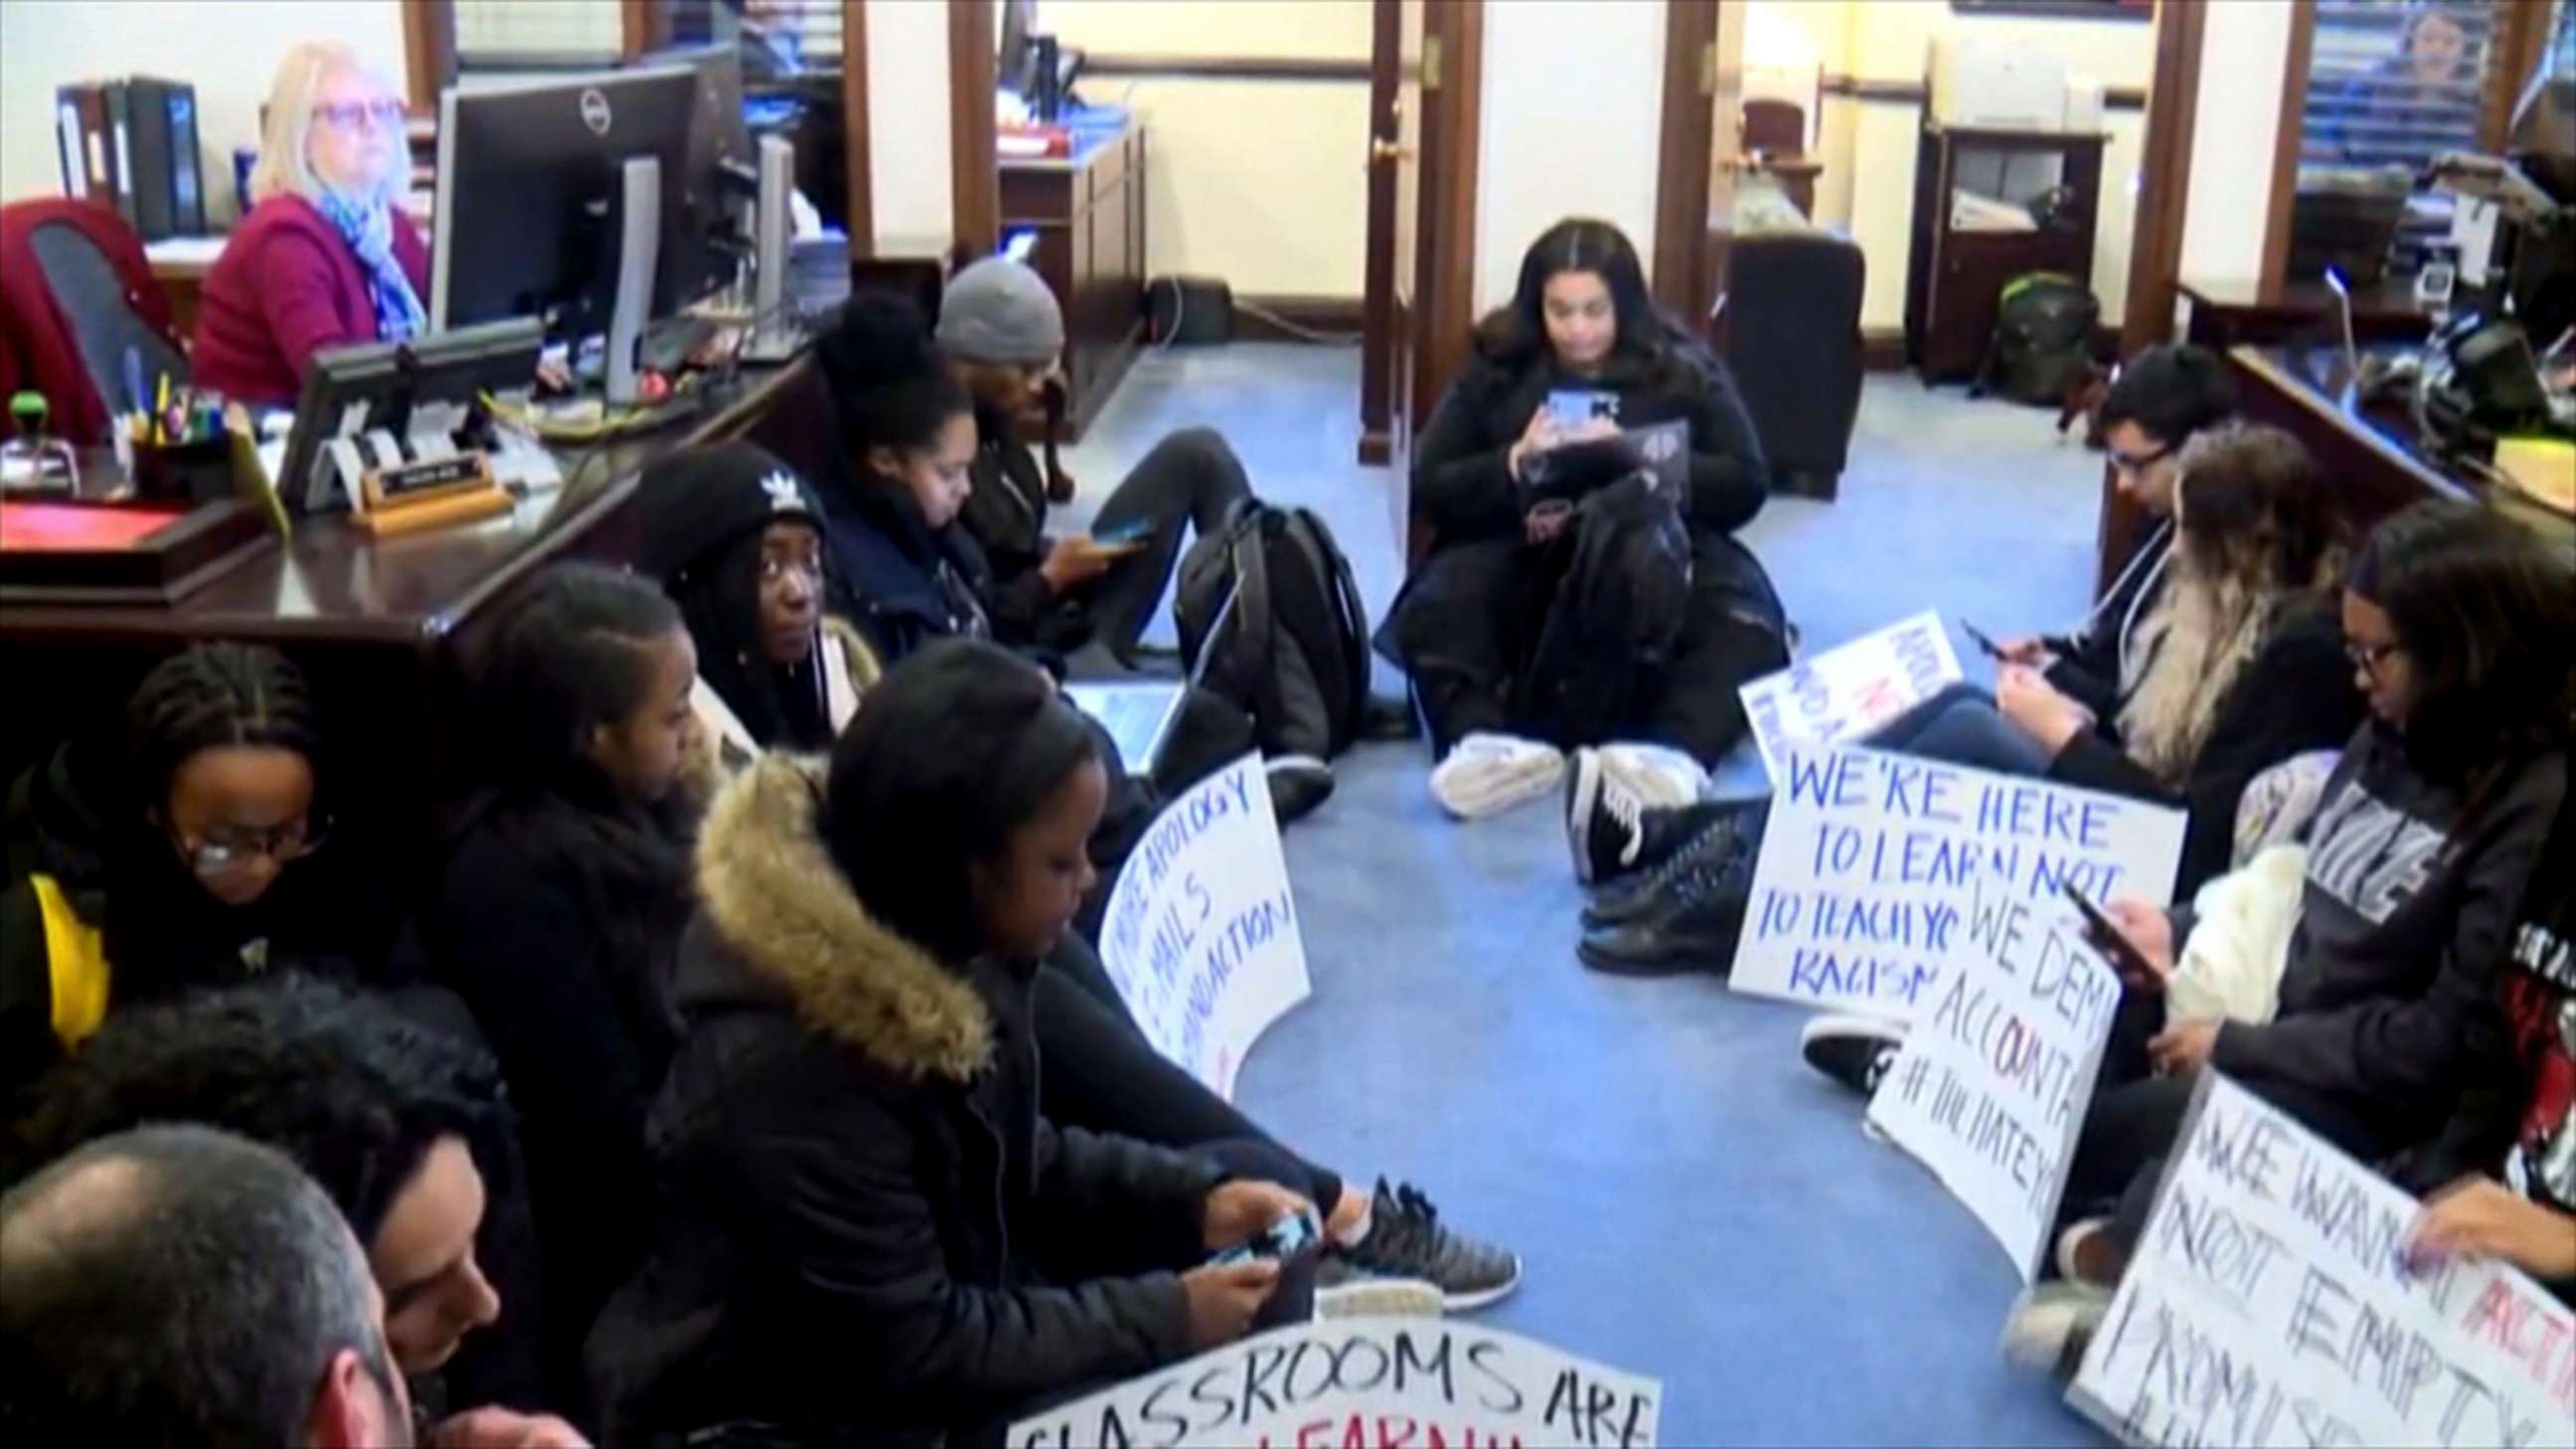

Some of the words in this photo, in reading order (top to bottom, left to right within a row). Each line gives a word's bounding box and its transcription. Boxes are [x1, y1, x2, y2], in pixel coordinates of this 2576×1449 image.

[1144, 767, 1250, 888] APOLOGY
[1789, 751, 1963, 823] WE'RE
[1978, 783, 2120, 850] HERE
[1758, 886, 1802, 939] TO
[1813, 823, 1861, 879] TO
[2029, 852, 2126, 906] NOT
[1970, 877, 2031, 976] WE
[2196, 1104, 2300, 1204] WE
[2158, 1183, 2297, 1301] NOT
[2285, 1264, 2539, 1449] EMPTY
[1542, 1368, 1654, 1448] ARE
